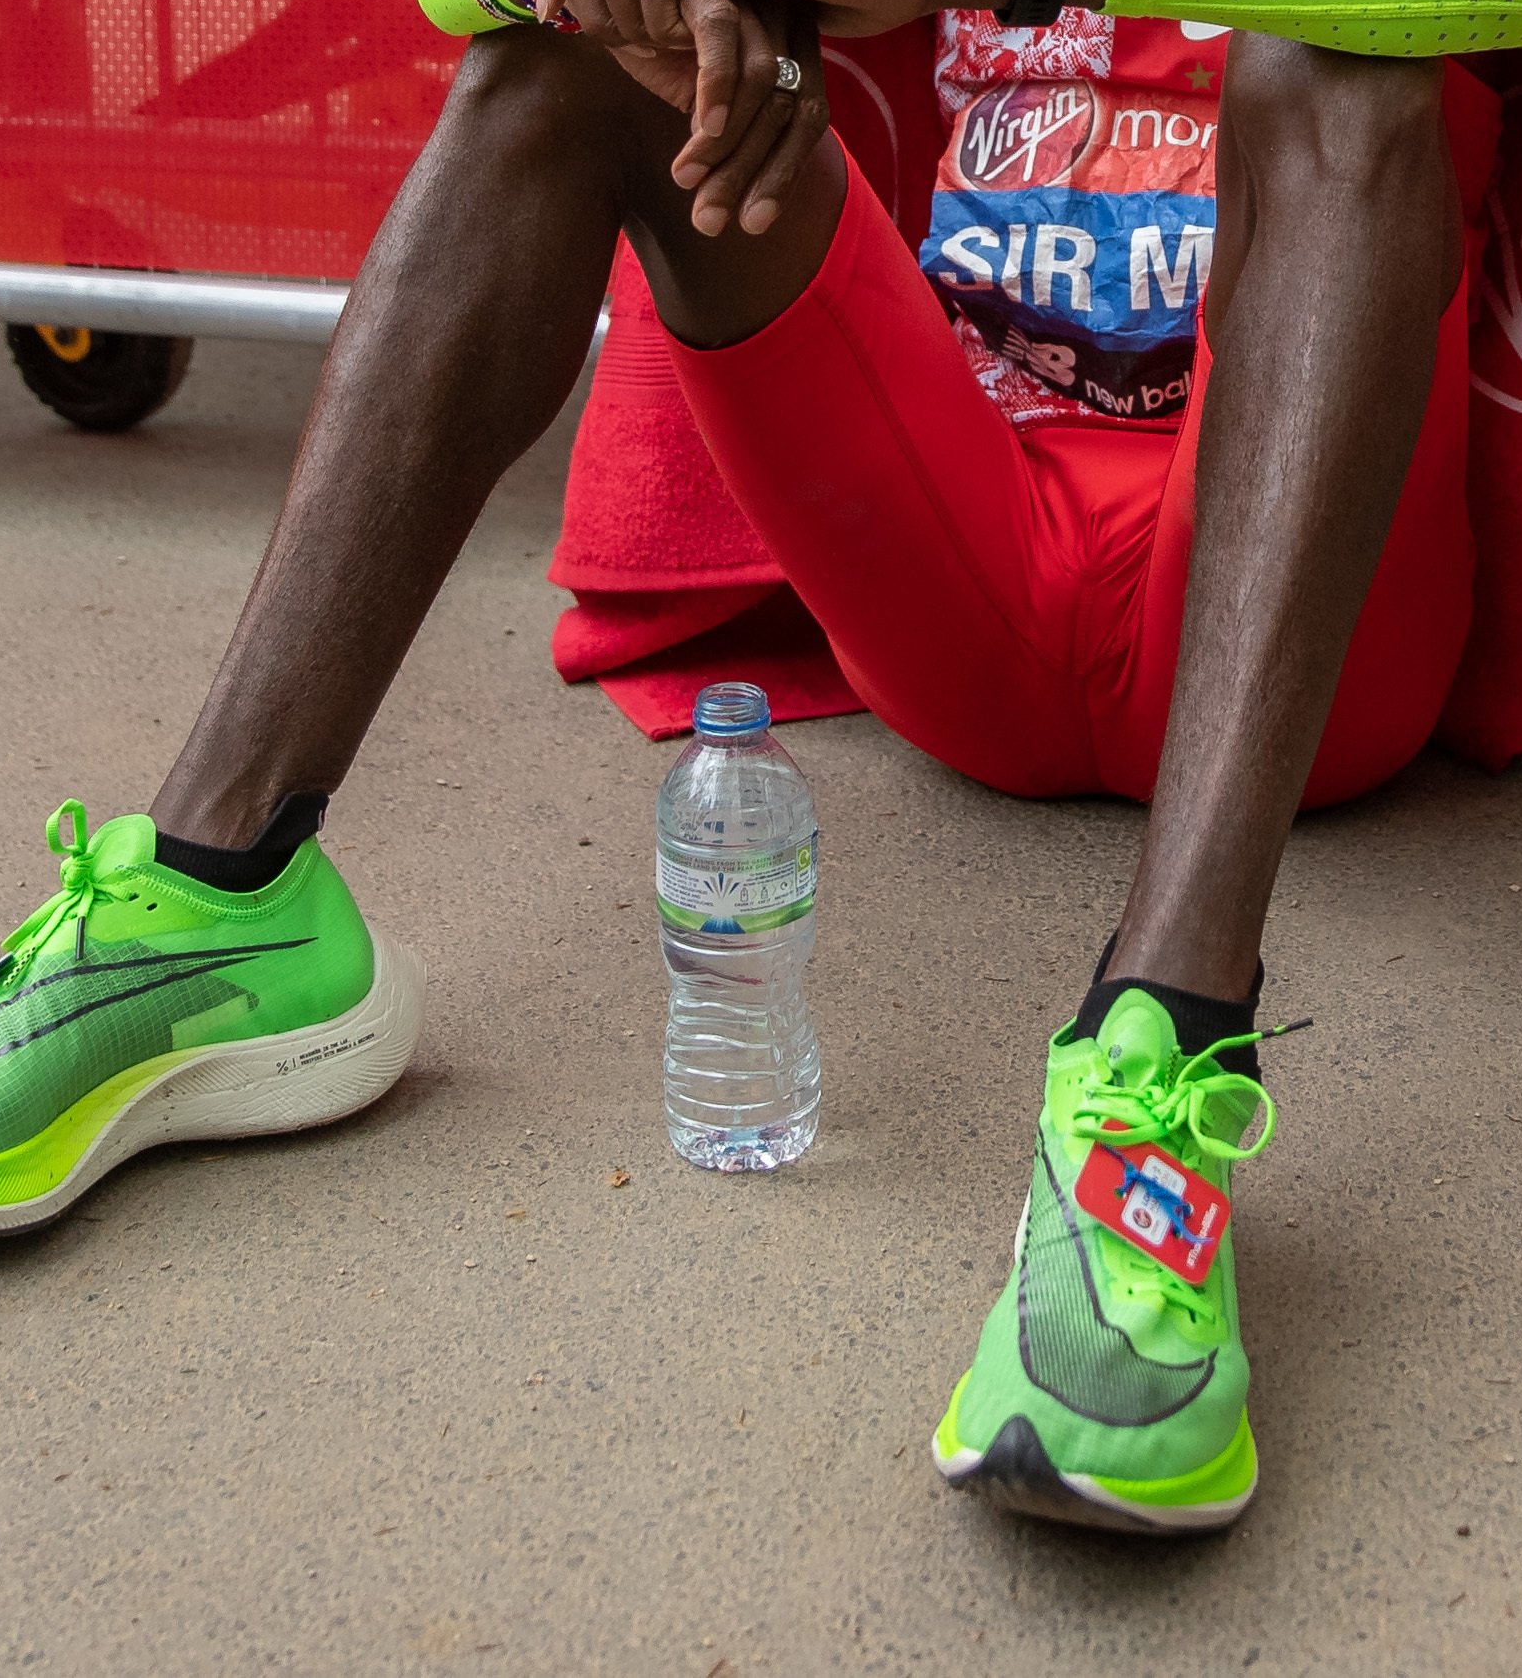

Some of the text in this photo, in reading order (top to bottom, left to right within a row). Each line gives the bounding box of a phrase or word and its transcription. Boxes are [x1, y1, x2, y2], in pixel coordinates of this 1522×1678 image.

[967, 79, 1090, 182] Virgin
[940, 223, 1097, 313] SIR
[1084, 377, 1135, 415] new
